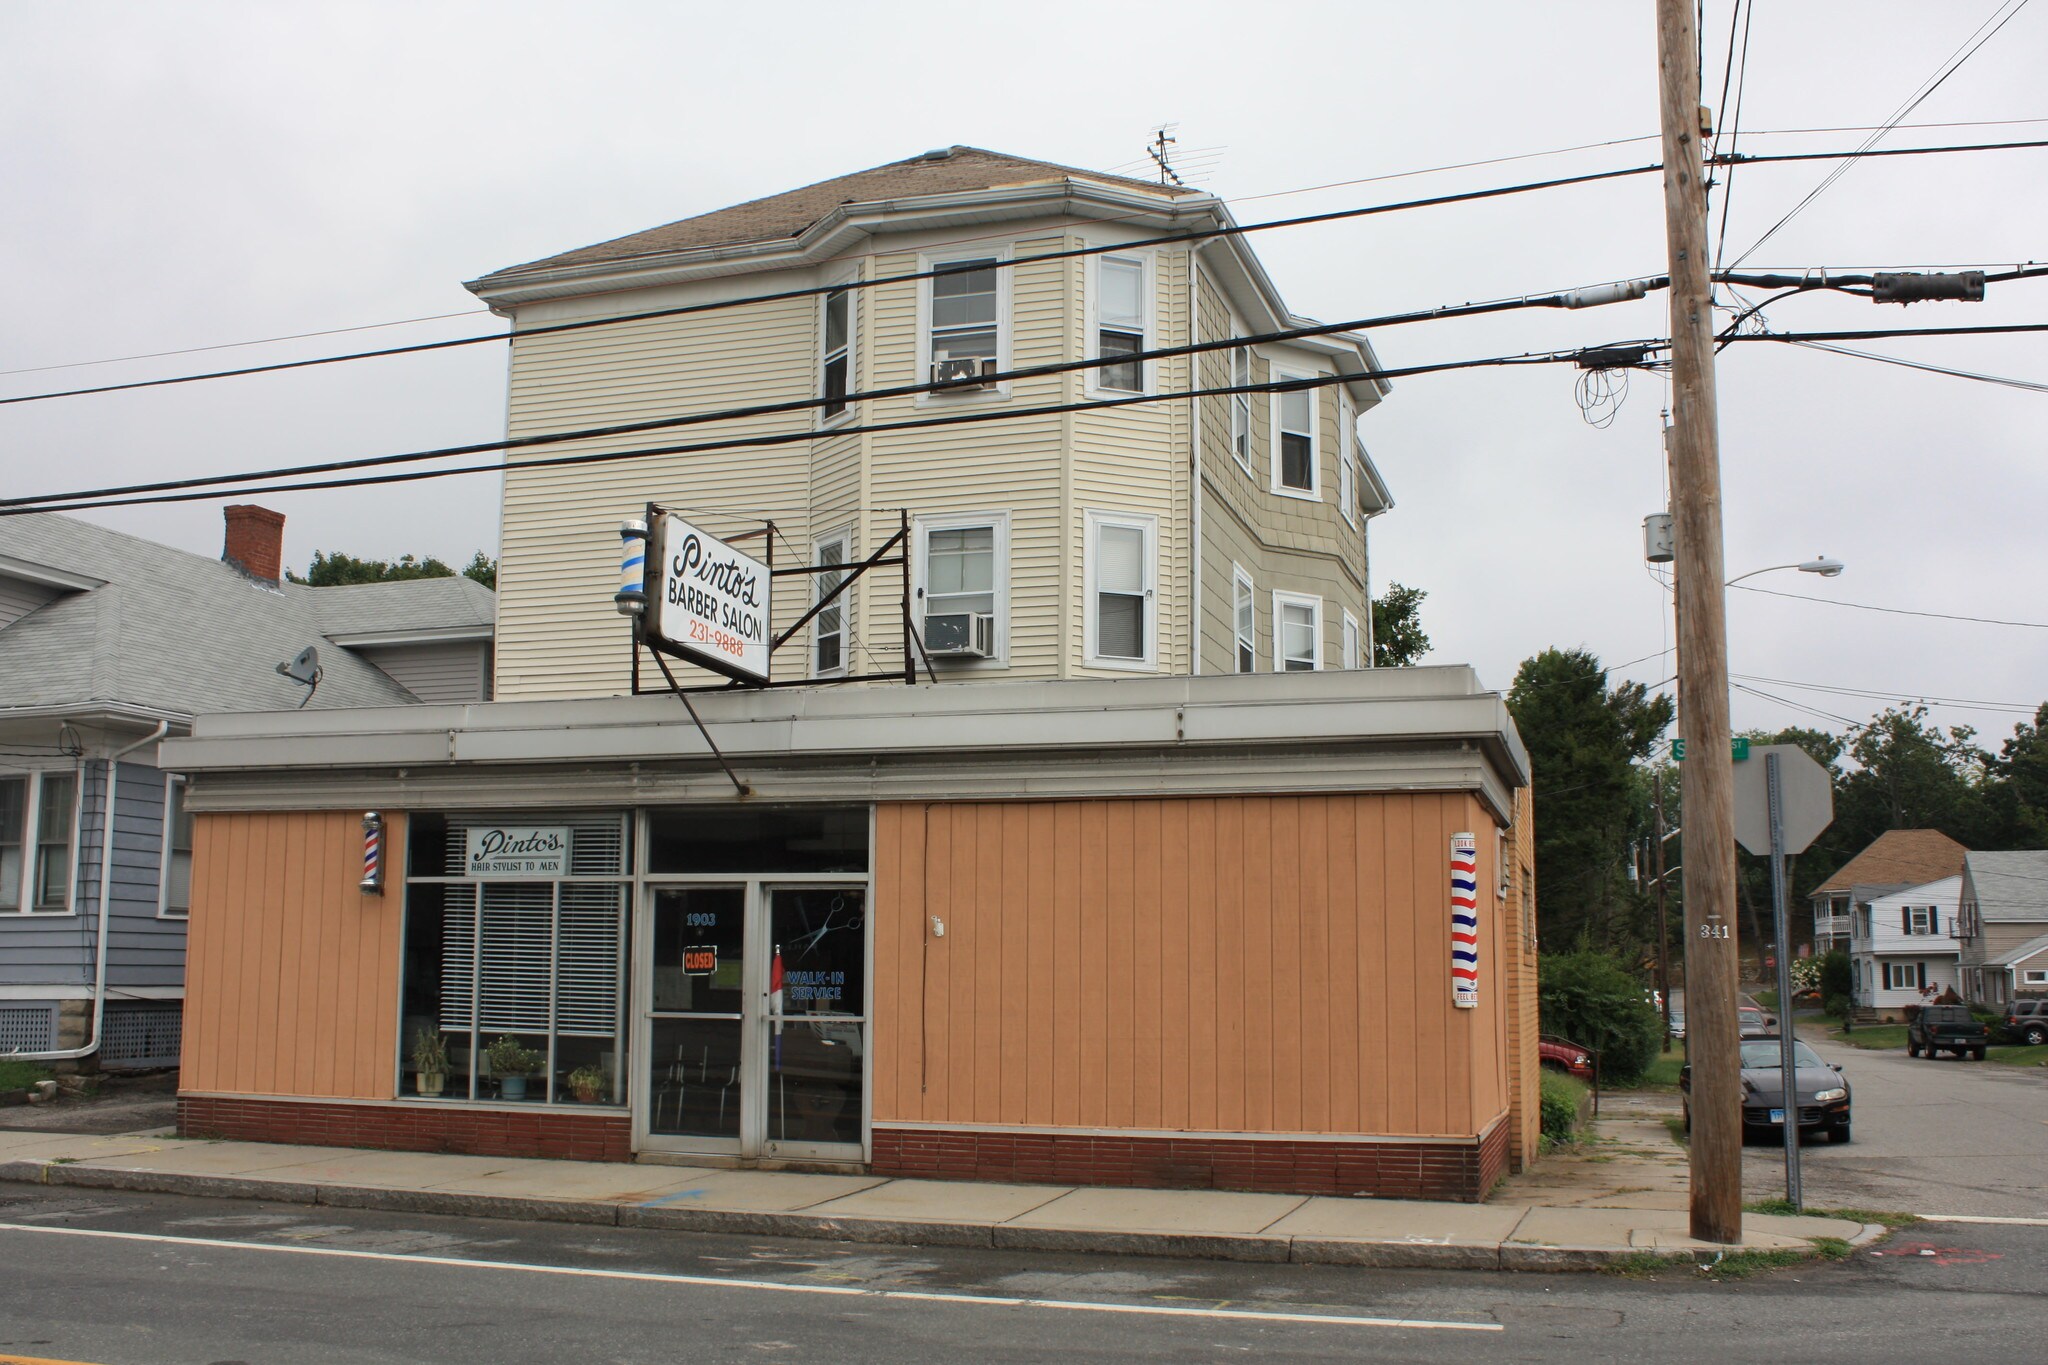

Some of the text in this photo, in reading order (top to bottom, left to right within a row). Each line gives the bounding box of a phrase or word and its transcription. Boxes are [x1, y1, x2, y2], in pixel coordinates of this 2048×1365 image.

[673, 534, 760, 608] Pinto's
[668, 577, 762, 643] BARBER SALON
[689, 620, 744, 658] 231-9888
[1732, 741, 1743, 749] ST
[474, 829, 564, 861] Pinto's
[1454, 839, 1467, 848] LOOK
[471, 861, 559, 872] HAIR STYLIST TO MEN
[686, 912, 716, 927] 1903
[1700, 924, 1730, 939] 341
[685, 952, 714, 969] CLOSED
[786, 971, 845, 985] WALK-IN
[791, 986, 842, 1000] SERVICE
[1456, 992, 1469, 1001] FEEL
